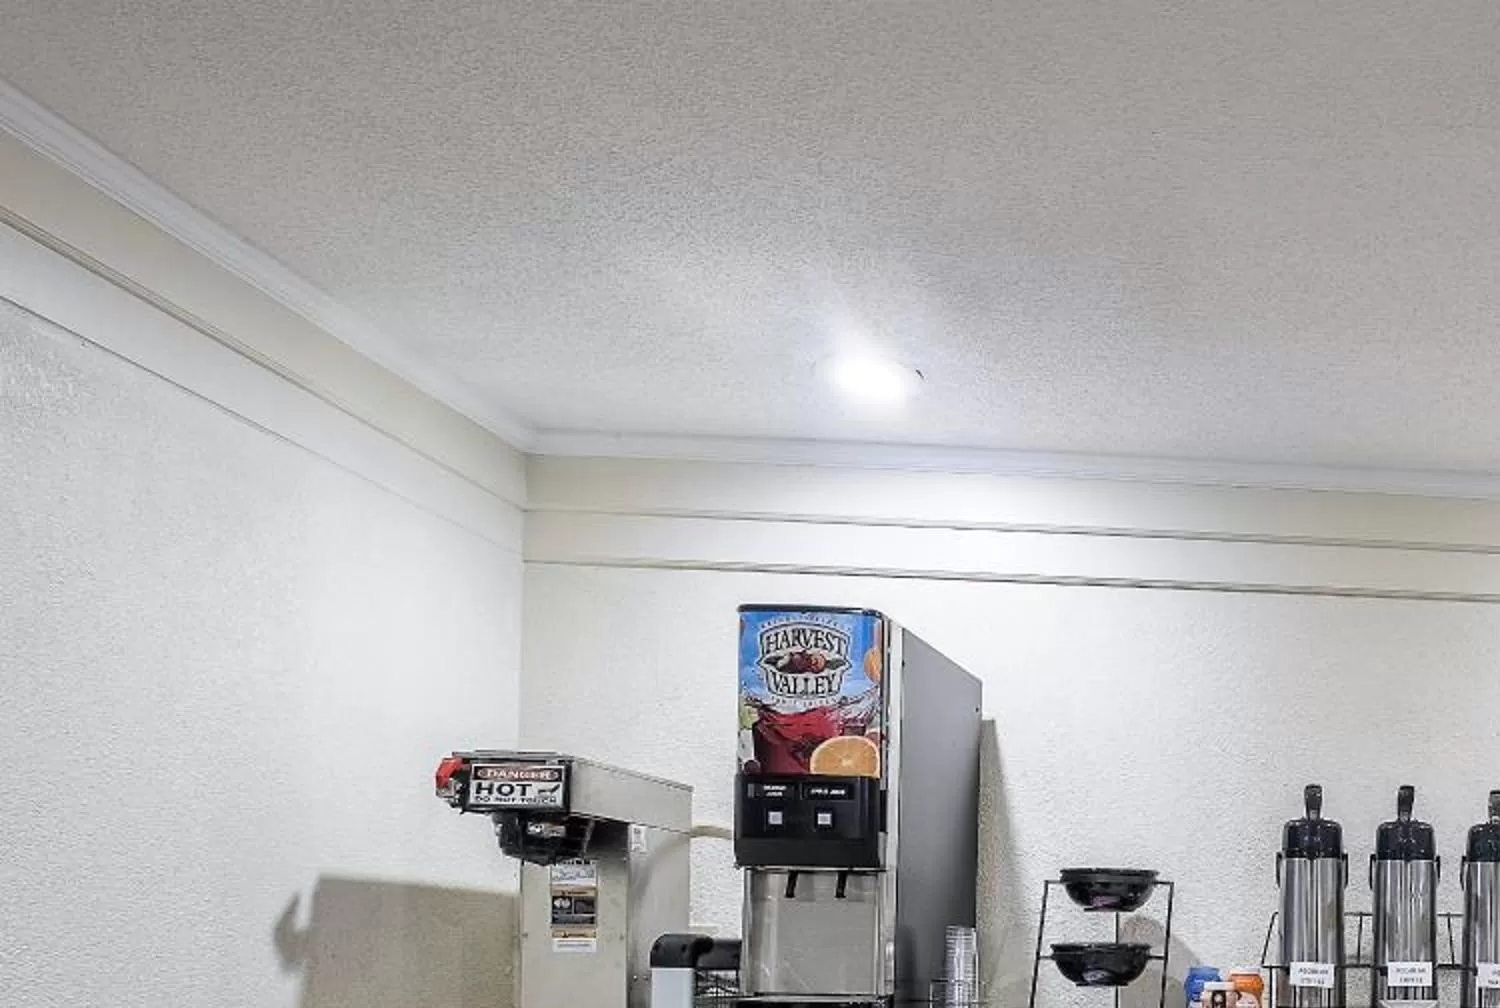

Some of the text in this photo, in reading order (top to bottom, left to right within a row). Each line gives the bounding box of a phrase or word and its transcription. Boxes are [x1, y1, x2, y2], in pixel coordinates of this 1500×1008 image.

[765, 628, 845, 655] HARVEST
[771, 671, 837, 695] VALLEY
[487, 768, 551, 780] DANGER
[475, 782, 532, 796] HOT
